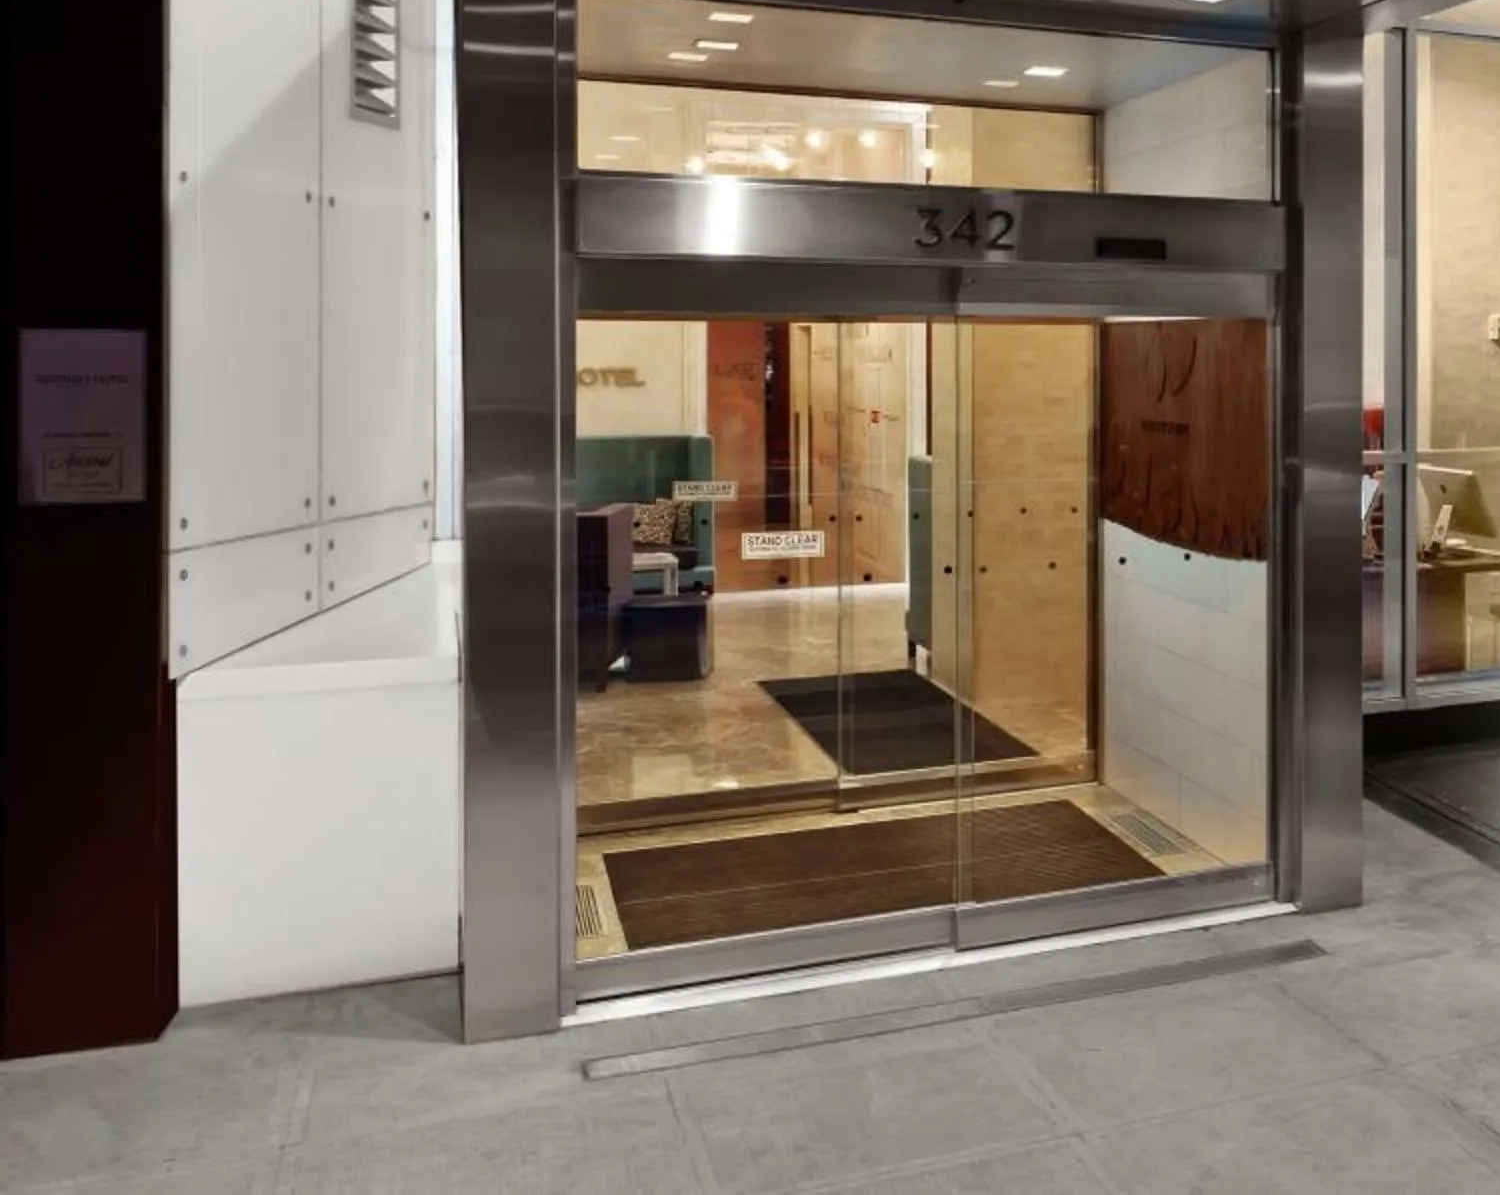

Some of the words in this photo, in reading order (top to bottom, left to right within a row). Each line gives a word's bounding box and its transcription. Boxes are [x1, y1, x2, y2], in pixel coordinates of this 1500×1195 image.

[914, 207, 1016, 251] 342
[577, 367, 647, 388] OTEL
[747, 535, 783, 547] STAND
[784, 534, 818, 546] CLEAR
